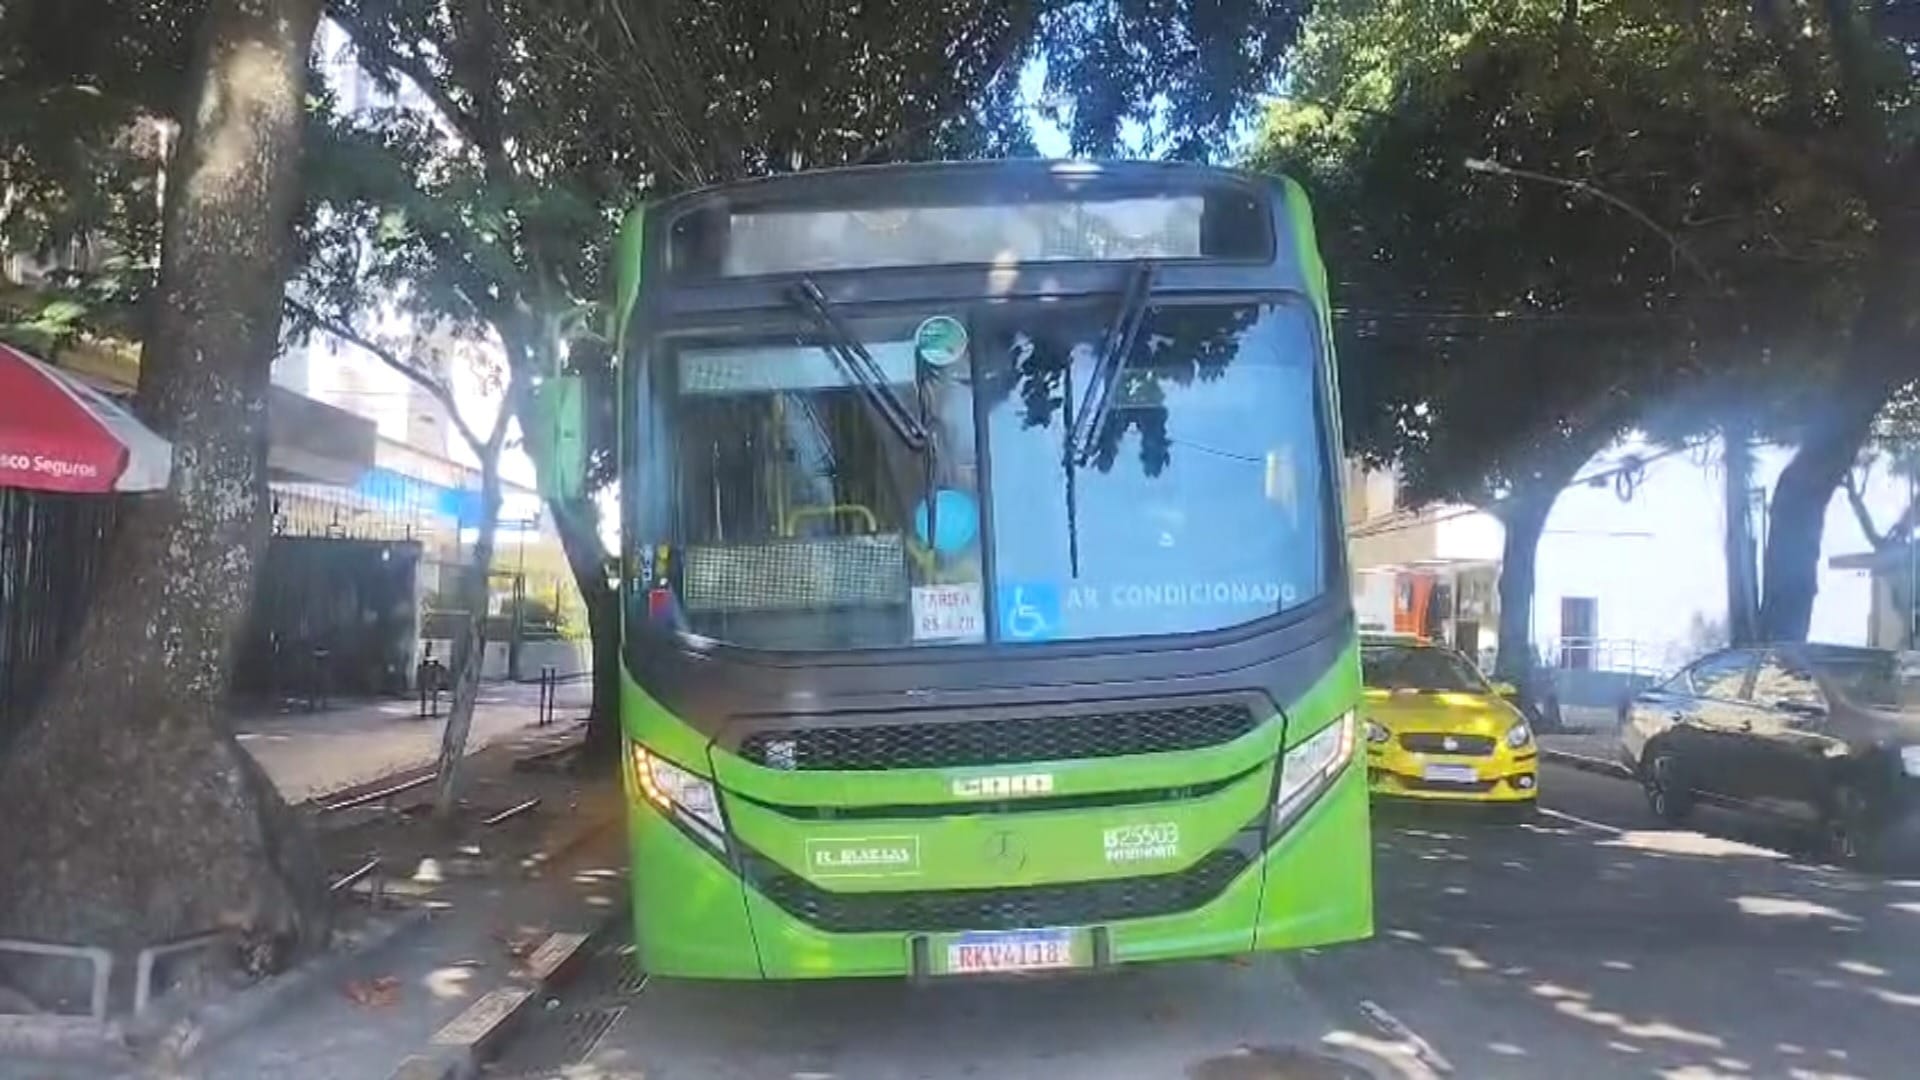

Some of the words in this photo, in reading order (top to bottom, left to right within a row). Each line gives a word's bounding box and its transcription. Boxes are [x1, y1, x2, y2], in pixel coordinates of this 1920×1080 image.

[33, 456, 97, 477] Seguros
[1067, 588, 1099, 608] AR
[1113, 582, 1297, 604] CONDICIONADO
[1104, 822, 1178, 847] B25503
